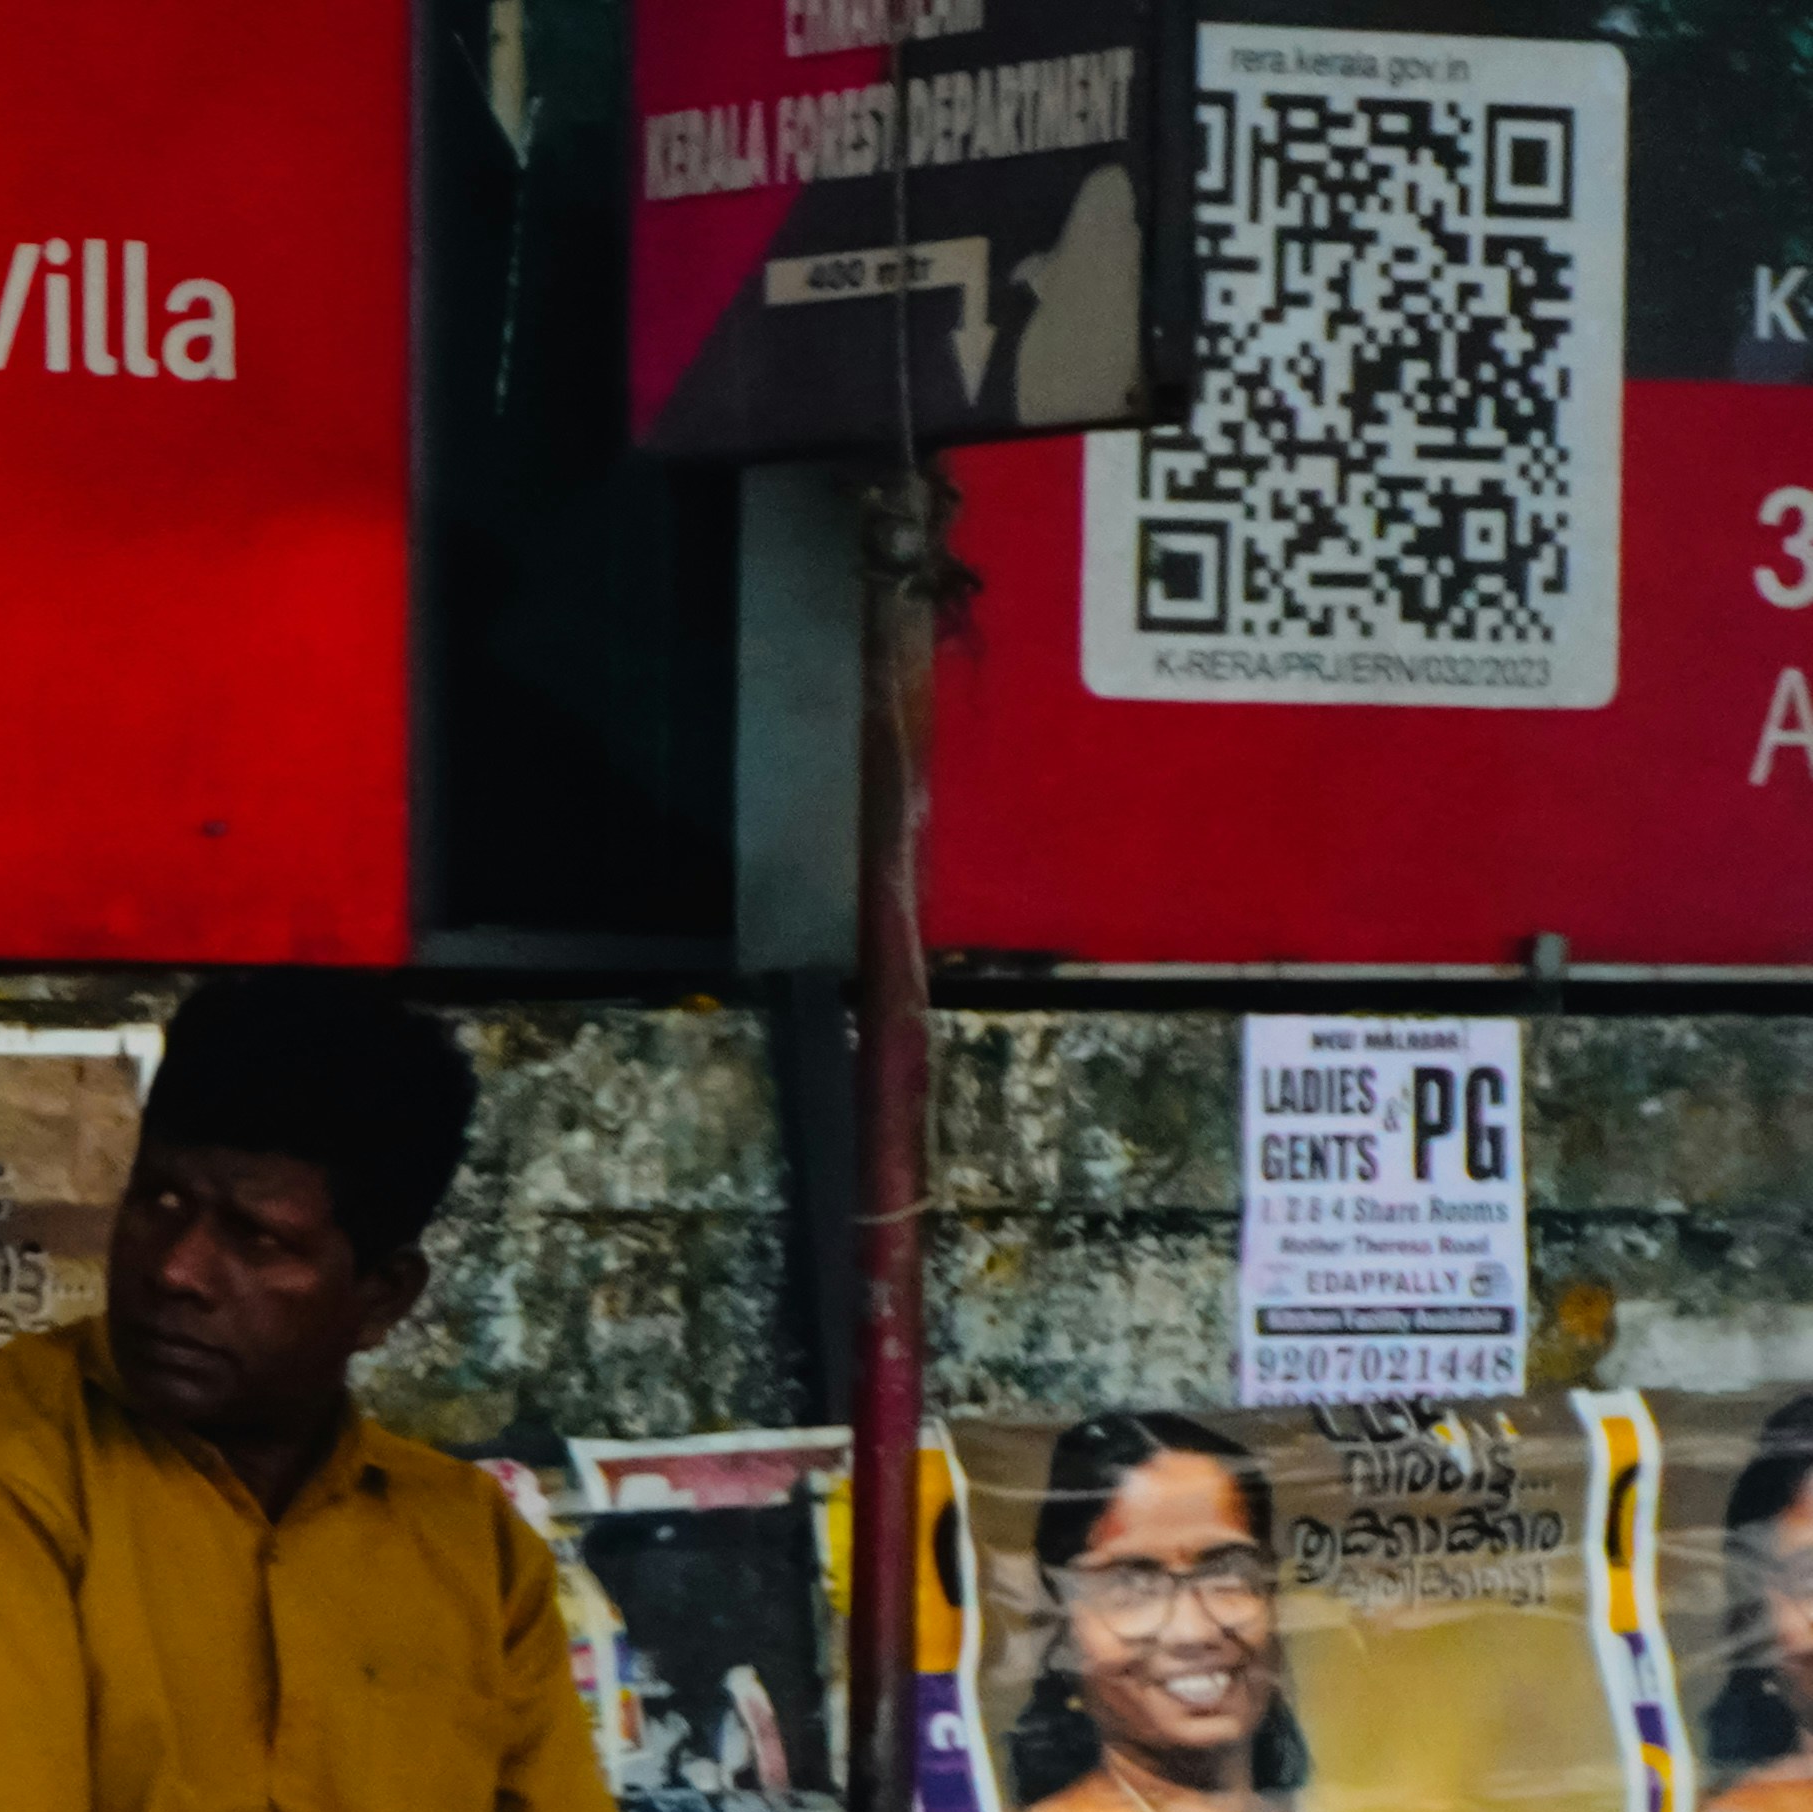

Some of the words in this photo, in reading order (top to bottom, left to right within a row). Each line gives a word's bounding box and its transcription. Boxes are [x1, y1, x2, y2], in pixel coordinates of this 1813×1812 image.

[1261, 1066, 1377, 1115] LADIES
[1413, 1065, 1507, 1181] PG
[1261, 1134, 1378, 1180] GENTS
[1307, 1269, 1459, 1295] EDAPPALLY
[1256, 1345, 1515, 1383] 9207021448
